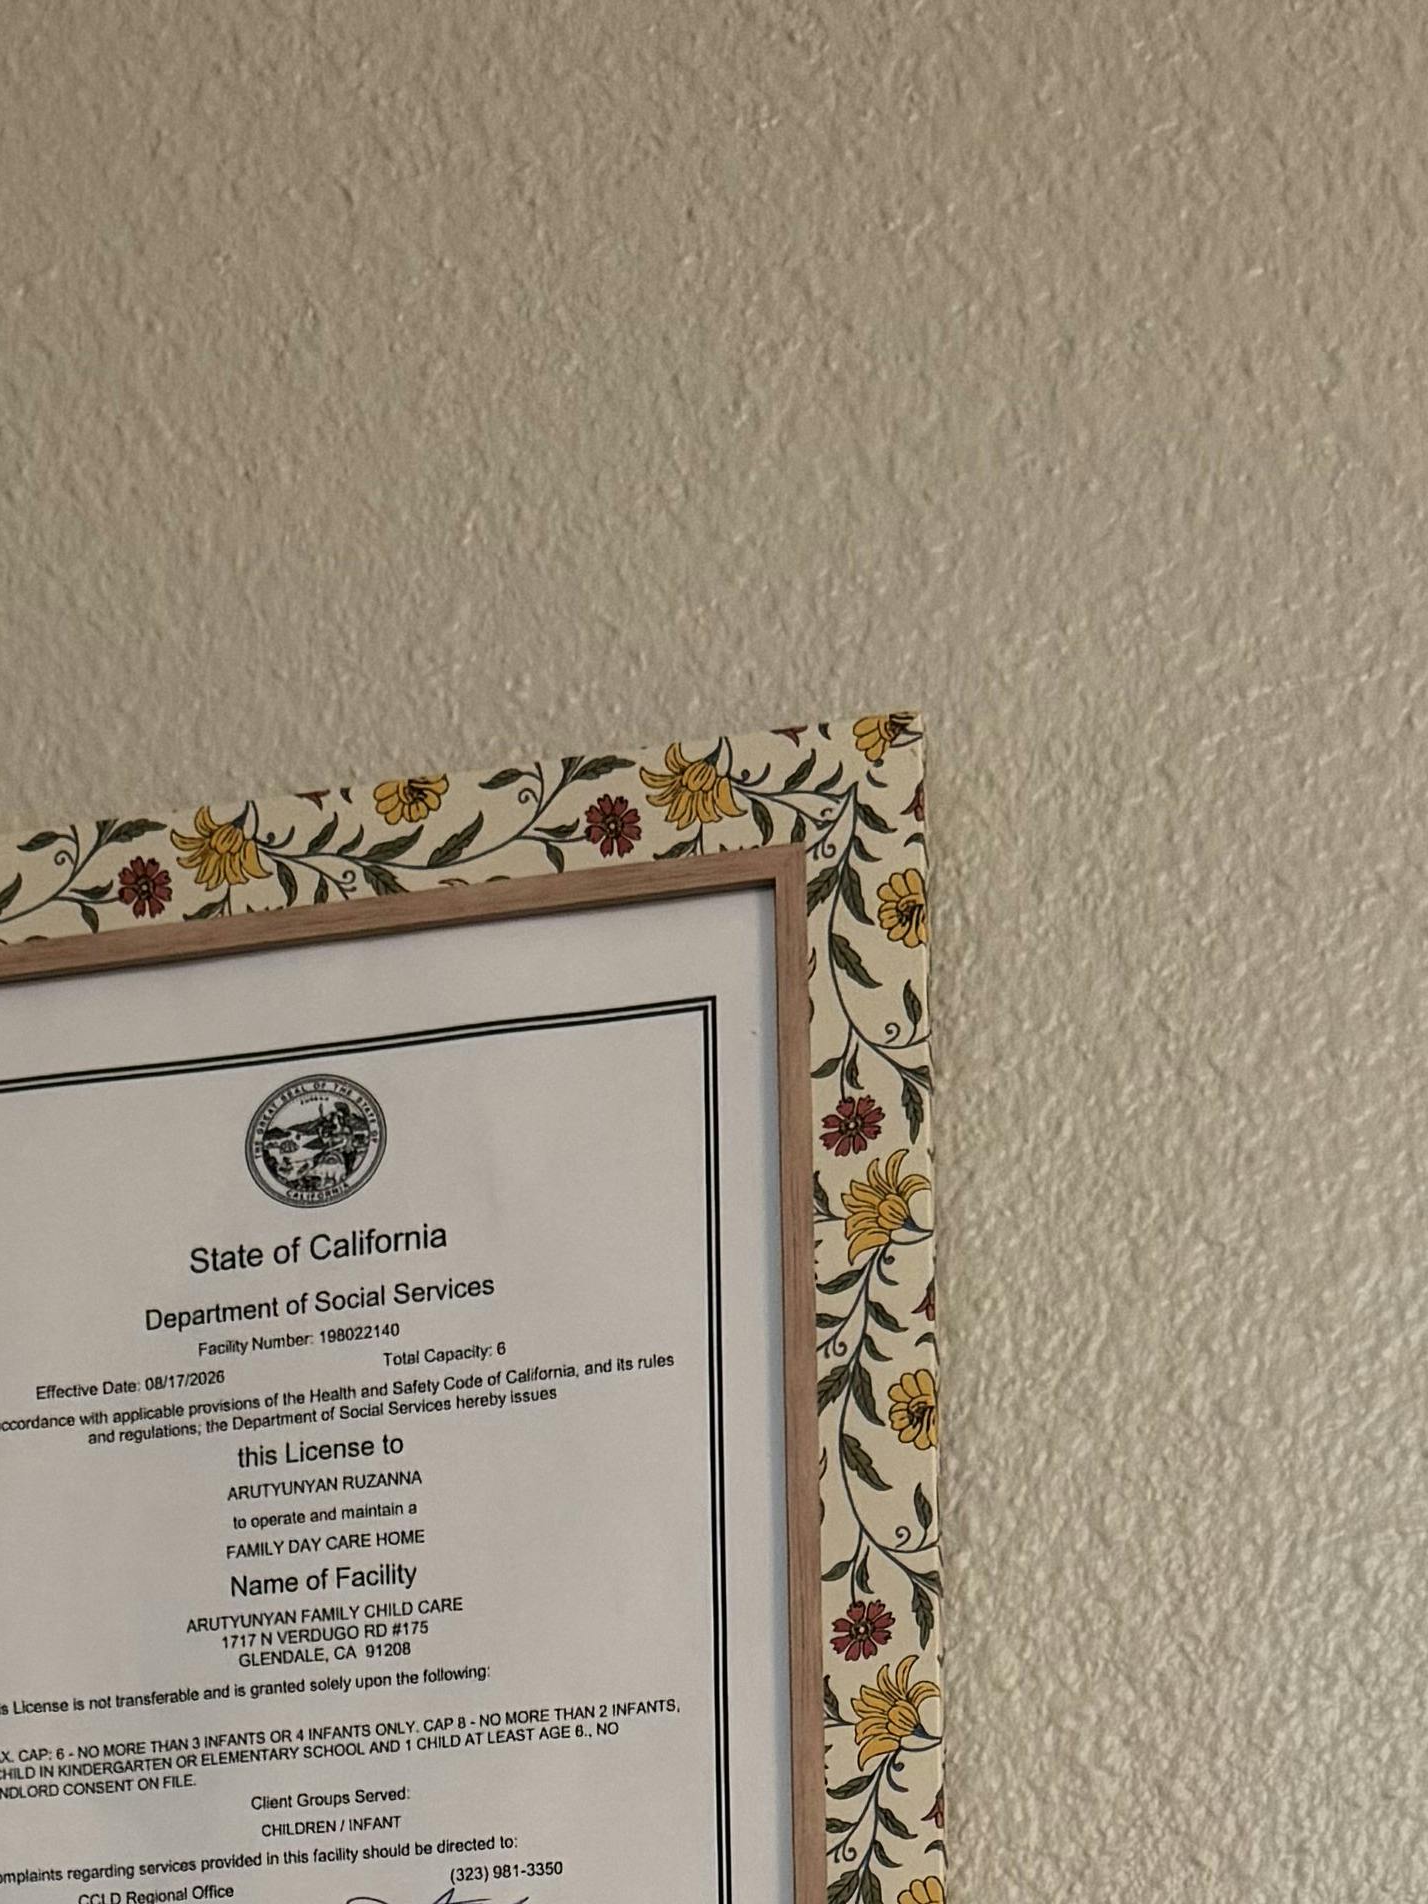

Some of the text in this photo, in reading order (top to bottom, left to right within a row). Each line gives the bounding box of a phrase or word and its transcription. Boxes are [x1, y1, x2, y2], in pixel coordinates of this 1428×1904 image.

[188, 1221, 447, 1274] State of California
[144, 1276, 495, 1333] Department of Social Services
[197, 1321, 400, 1357] Facility Number: 198022140
[381, 1340, 507, 1367] Total Capacity: 6
[34, 1368, 225, 1400] Effective Date: 08/17/2026
[236, 1433, 404, 1469] this License to
[226, 1469, 423, 1502] ARUTYUNYAN RUZANNA
[229, 1561, 417, 1597] Name of Facility
[449, 1860, 563, 1886] (323) 981-3350
[190, 1883, 235, 1900] Office
